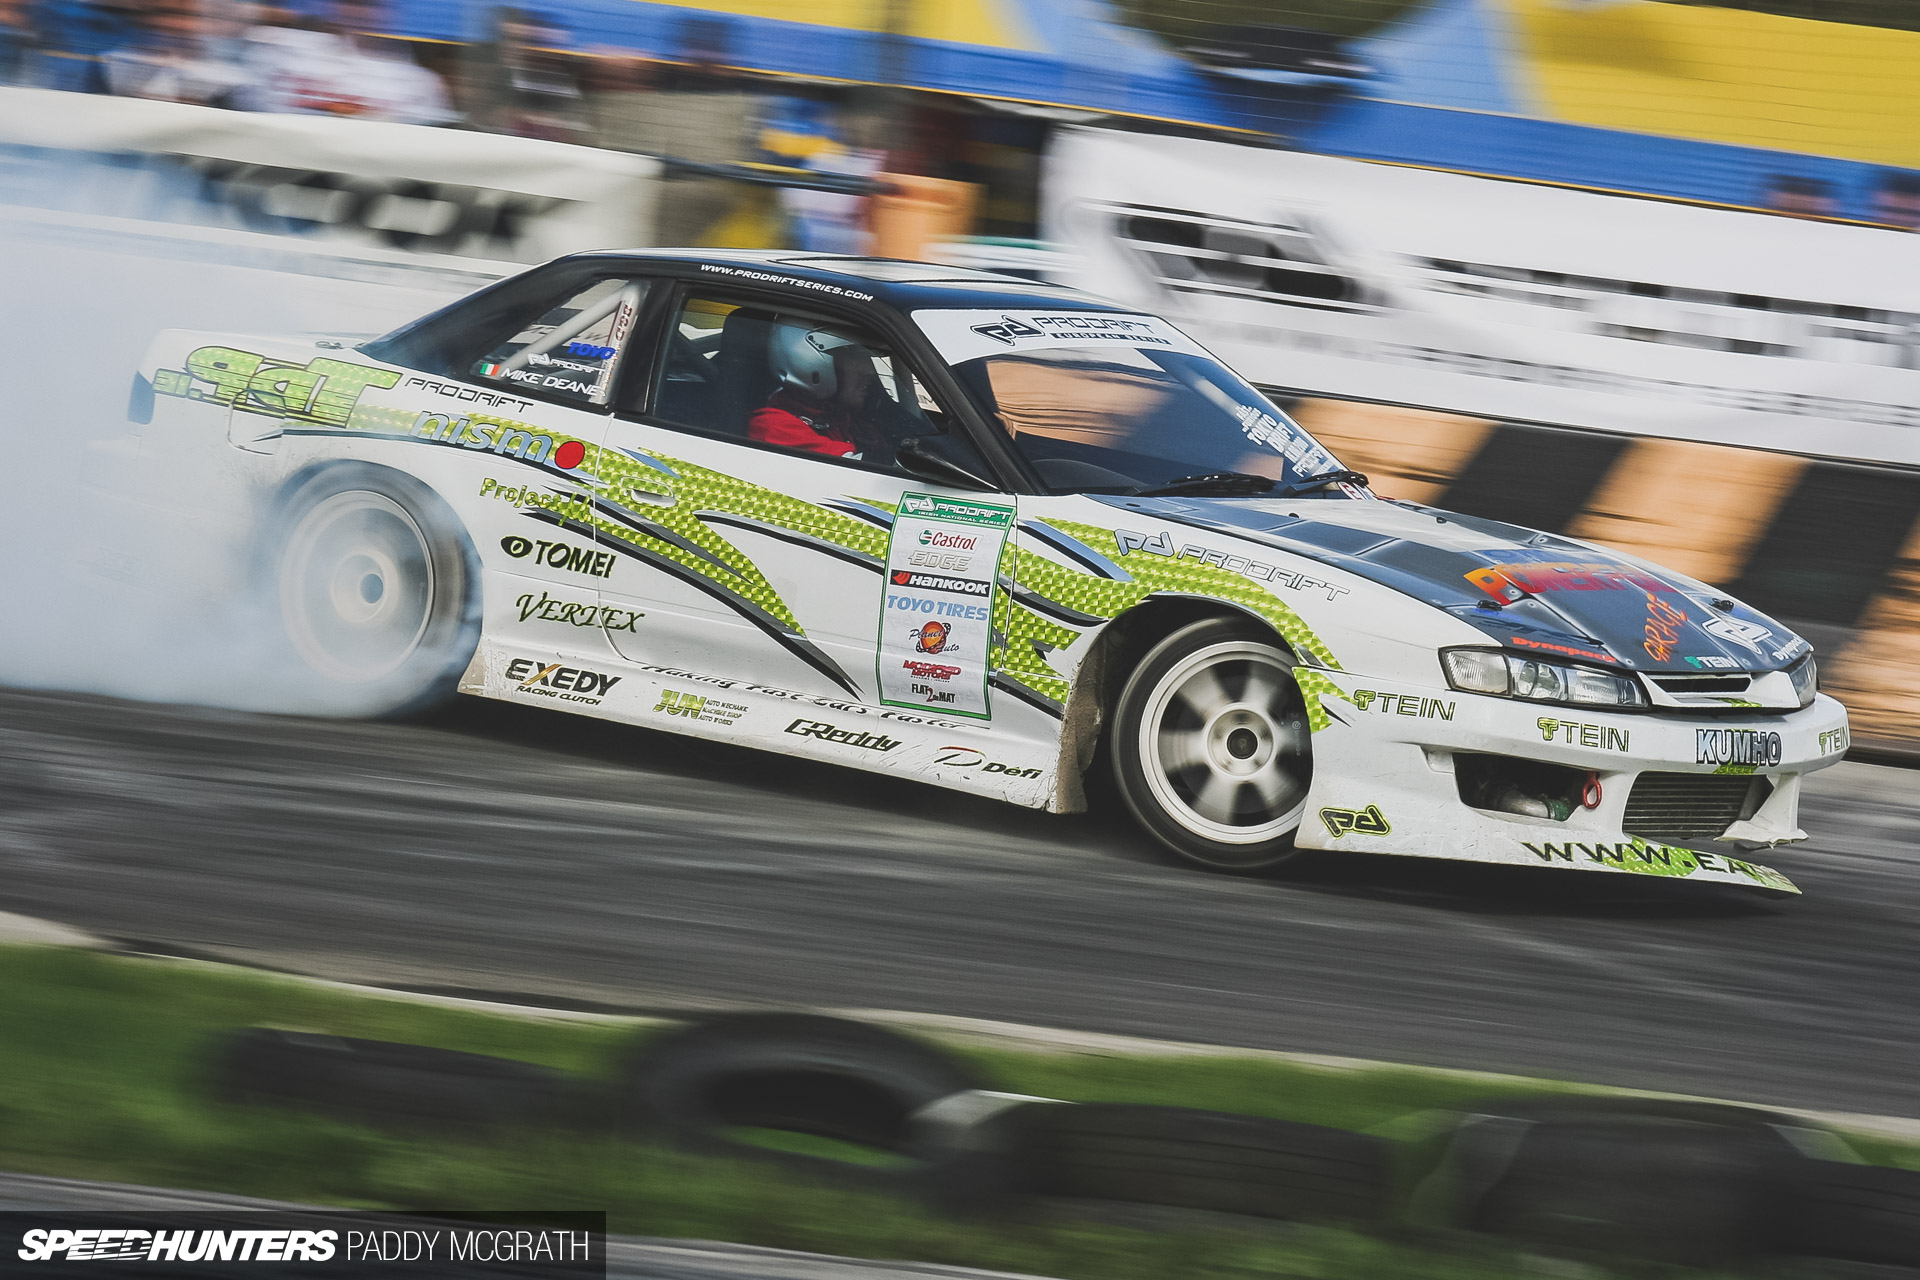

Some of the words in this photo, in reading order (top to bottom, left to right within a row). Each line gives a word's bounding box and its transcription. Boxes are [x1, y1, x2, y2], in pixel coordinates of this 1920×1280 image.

[1031, 316, 1153, 334] PRODRIFT
[568, 342, 616, 360] TOYO
[405, 377, 534, 413] PRODRIFT
[500, 368, 543, 384] MIKE
[542, 376, 604, 397] DEANE
[408, 410, 586, 469] nismo
[479, 477, 562, 512] Project
[935, 503, 1011, 520] PRODRIFT
[940, 513, 977, 523] NATIONAL
[931, 531, 978, 551] Castrol
[535, 539, 617, 578] TOMEI
[908, 550, 972, 572] EDGE
[1177, 543, 1351, 601] PRODRIFT
[516, 591, 646, 634] VERTEX
[887, 595, 935, 614] TOYO
[937, 601, 989, 621] TIRES
[1697, 656, 1740, 668] TEIN
[505, 658, 623, 697] EXEDY
[516, 685, 558, 698] RACING
[558, 692, 602, 706] CLUTCH
[652, 689, 707, 719] JUN
[706, 699, 721, 707] AUTO
[1377, 692, 1456, 722] TEIN
[784, 718, 903, 752] GReddy
[1559, 720, 1630, 753] TEIN
[1696, 728, 1782, 767] KUMHO
[1826, 725, 1850, 753] TEIN
